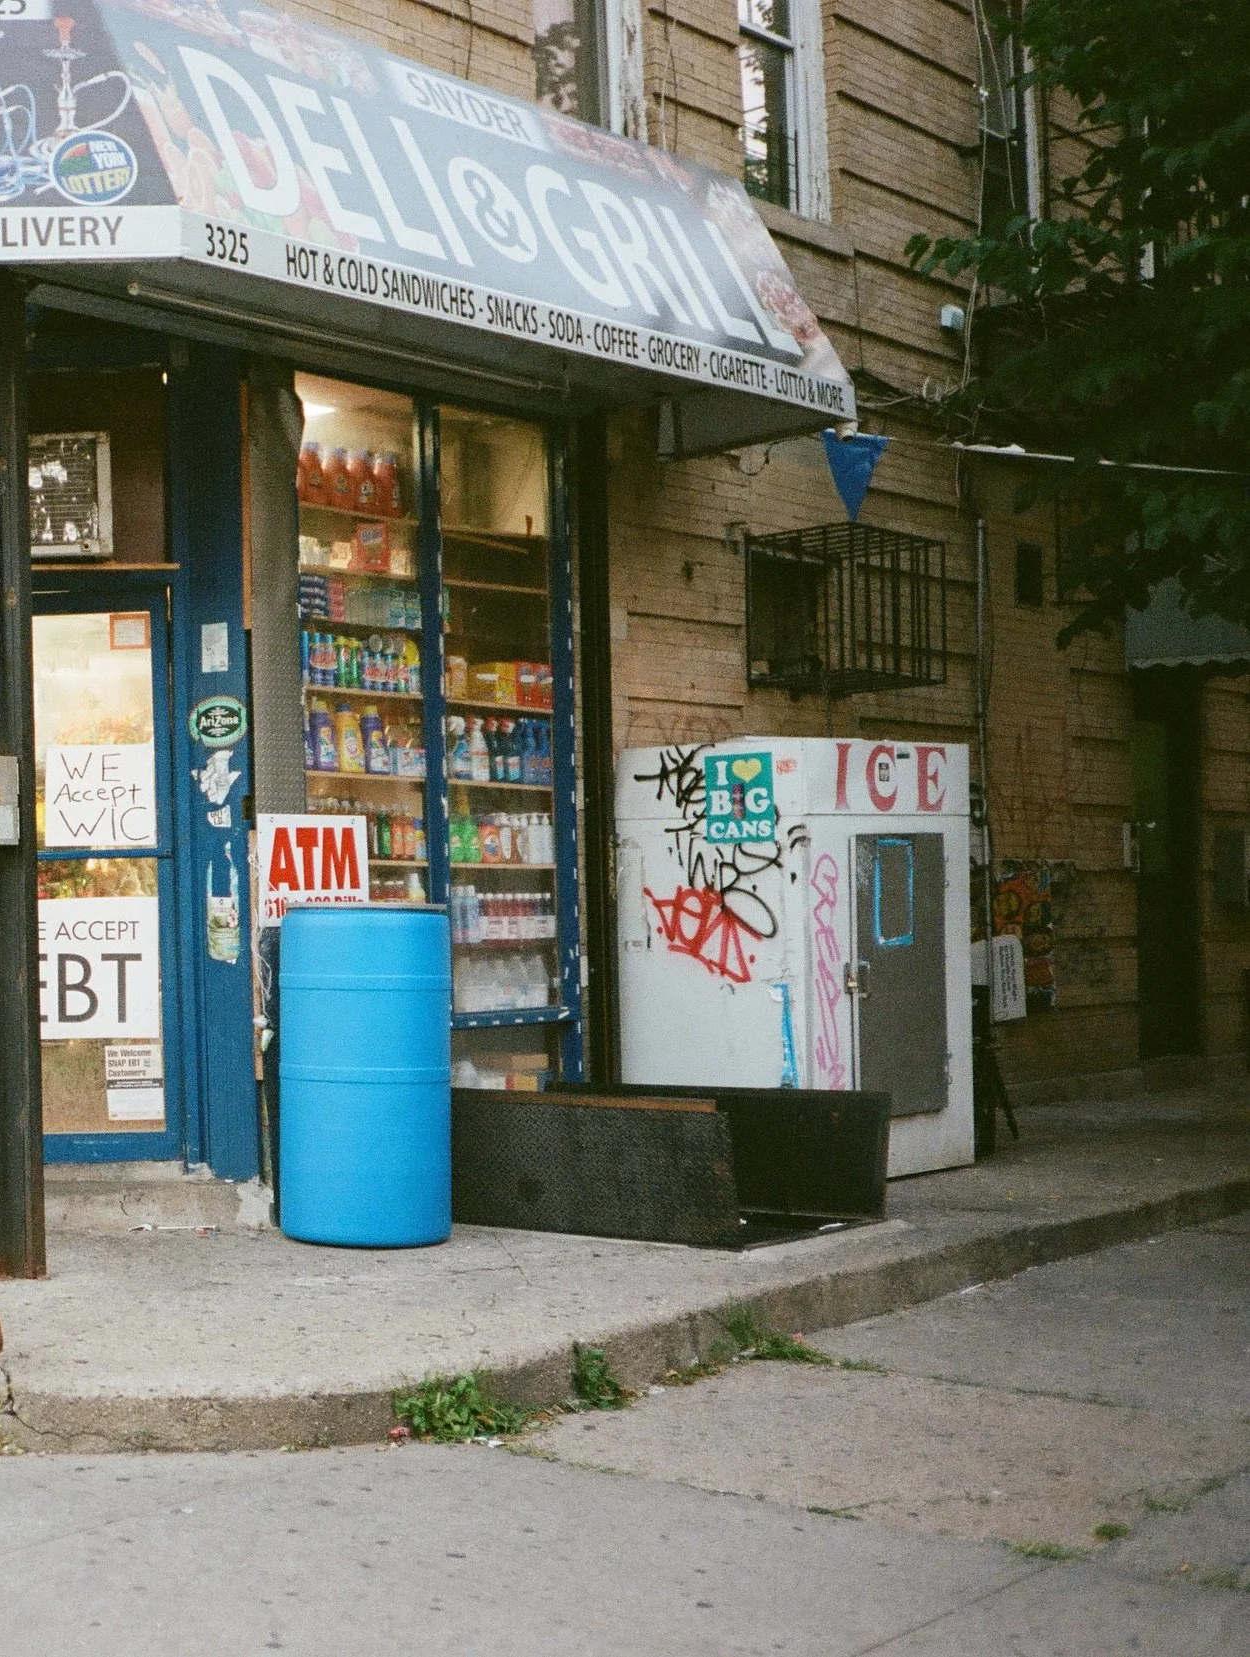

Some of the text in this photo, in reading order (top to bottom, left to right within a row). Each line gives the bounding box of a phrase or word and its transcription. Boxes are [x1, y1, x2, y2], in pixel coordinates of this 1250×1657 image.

[407, 73, 534, 142] SNYDER
[177, 46, 475, 268] DELI
[525, 164, 806, 358] GRILL
[205, 226, 249, 265] 3325
[286, 243, 318, 282] HOT
[323, 253, 334, 286] &
[337, 257, 378, 295] COLD
[382, 267, 475, 319] SANDWICHES
[487, 295, 537, 335] SNACKS
[549, 310, 584, 346] SODA
[593, 323, 638, 359] COFFEE
[648, 335, 700, 374] GROCERY
[710, 351, 767, 390] CIGARETTE
[774, 369, 806, 400] LOTTO
[817, 380, 845, 412] MORE
[61, 752, 121, 782] WE
[715, 761, 729, 786] I
[834, 743, 948, 812] ICE
[54, 783, 141, 806] Accept
[710, 820, 772, 839] CANS
[268, 827, 360, 892] ATM
[37, 921, 140, 941] E ACCEPT
